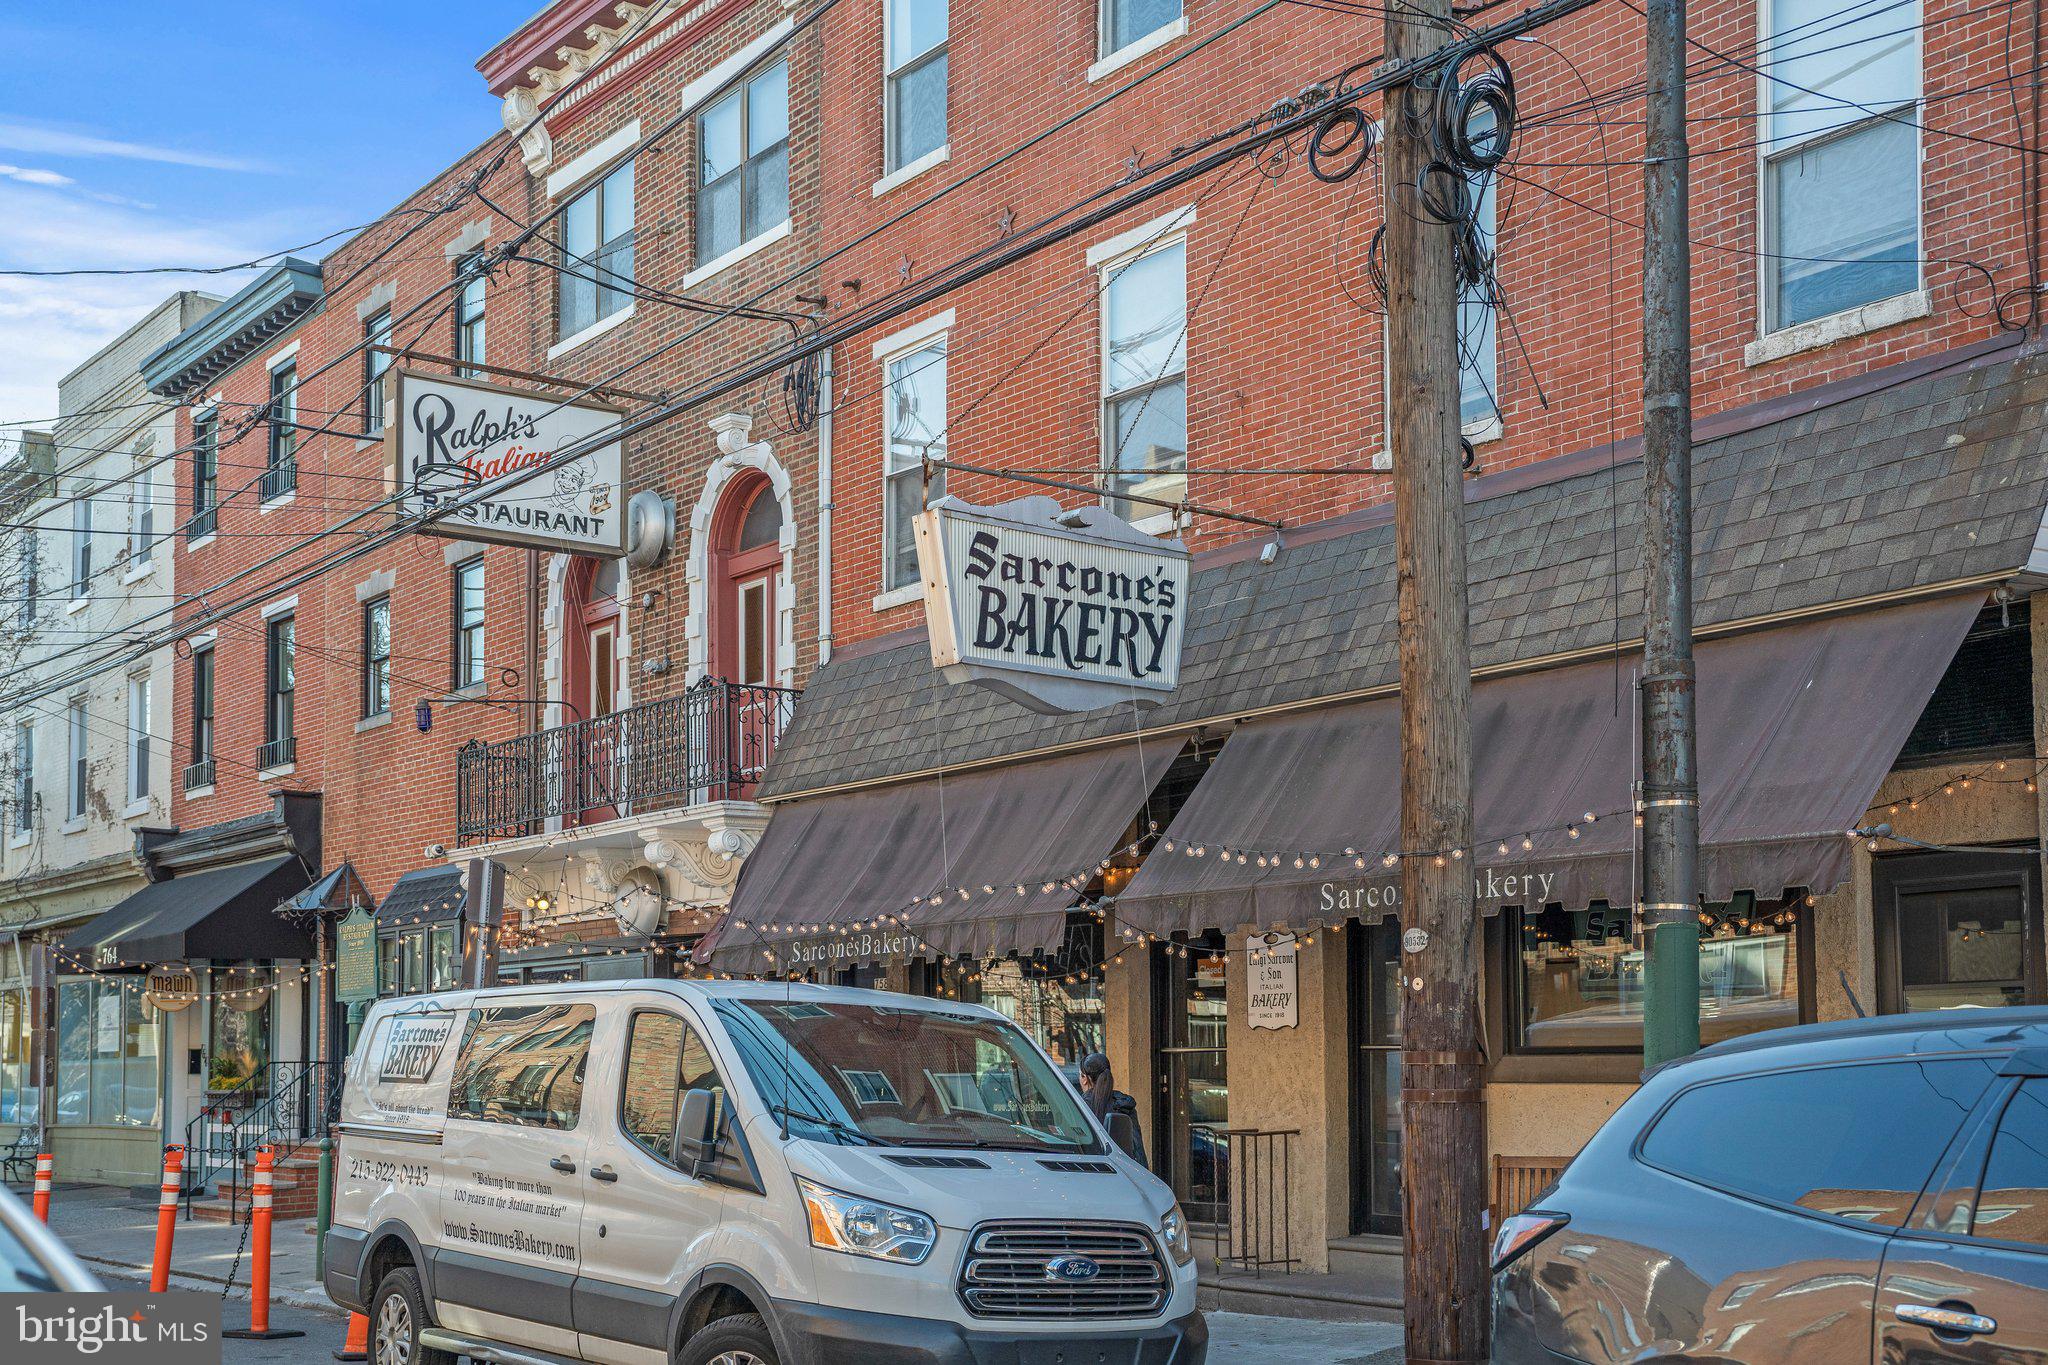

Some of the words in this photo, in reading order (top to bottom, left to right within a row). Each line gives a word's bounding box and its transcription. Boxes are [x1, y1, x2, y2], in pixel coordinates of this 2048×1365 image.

[413, 393, 539, 477] Ralph's
[456, 445, 553, 492] Italian
[965, 531, 1176, 609] Sarcone's
[973, 584, 1173, 679] BAKERY
[1320, 883, 1401, 911] Sarco
[102, 947, 117, 964] 764
[1267, 953, 1294, 965] Sarcone
[151, 974, 192, 992] mawn
[1267, 967, 1282, 980] Son
[1251, 992, 1293, 1009] BAKERY
[389, 1021, 448, 1044] Sarcone's
[383, 1044, 442, 1080] BAKERY
[350, 1159, 429, 1187] 215-922-0445
[504, 1176, 515, 1189] for
[516, 1181, 535, 1193] more
[535, 1181, 553, 1196] than
[454, 1189, 467, 1202] 100
[466, 1193, 486, 1208] years
[486, 1196, 495, 1205] in
[495, 1196, 507, 1210] the
[507, 1196, 534, 1213] Italian
[535, 1203, 567, 1218] market"
[443, 1219, 576, 1262] www.SarconesBakery.com
[1065, 1261, 1092, 1275] Ford
